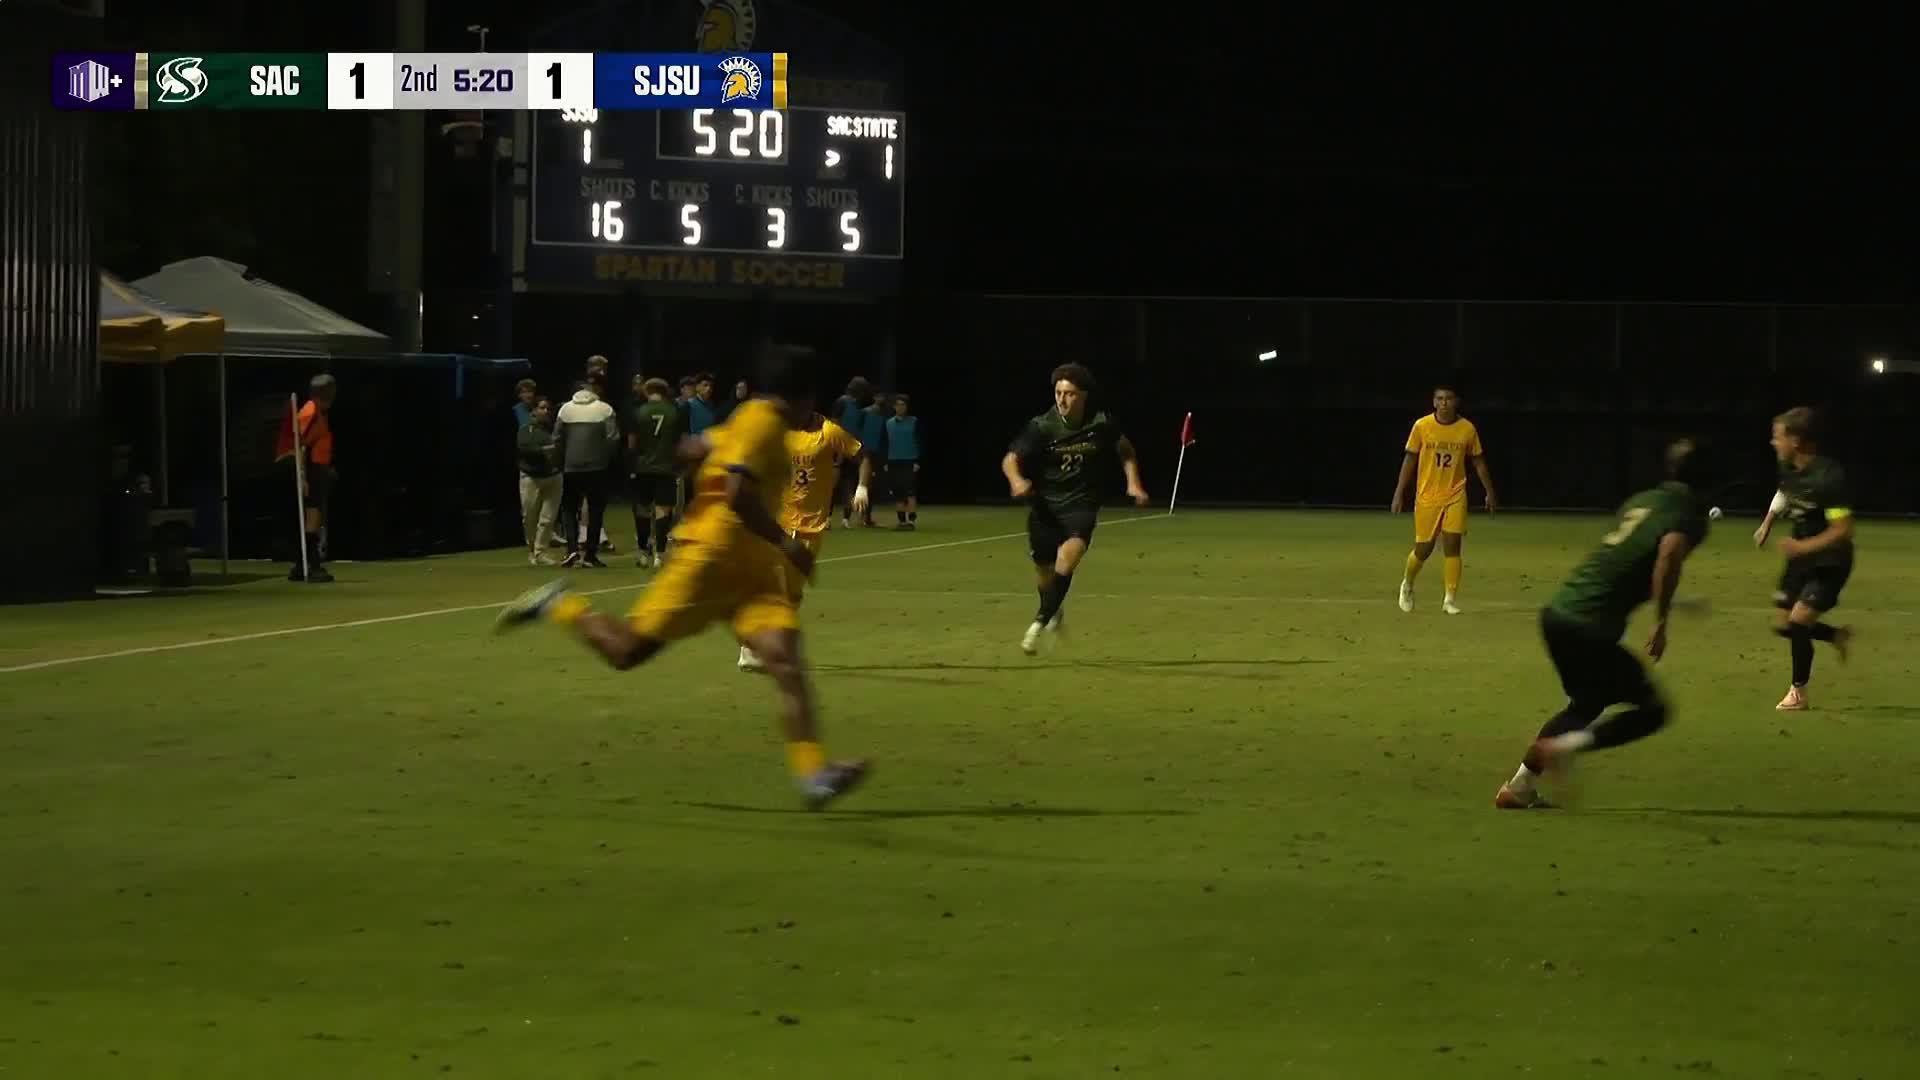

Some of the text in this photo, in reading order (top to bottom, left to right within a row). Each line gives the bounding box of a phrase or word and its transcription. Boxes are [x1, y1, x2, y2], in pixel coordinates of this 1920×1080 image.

[582, 129, 592, 164] 1
[884, 144, 894, 179] 1
[580, 177, 636, 199] SHOTS
[806, 187, 859, 209] SHOTS
[591, 201, 624, 242] 16
[681, 204, 701, 245] 5
[767, 207, 785, 248] 3
[840, 211, 861, 251] 5
[595, 254, 846, 286] SPARTAN SOCCER
[651, 415, 664, 436] 7
[795, 468, 809, 485] 3
[1435, 452, 1453, 468] 12
